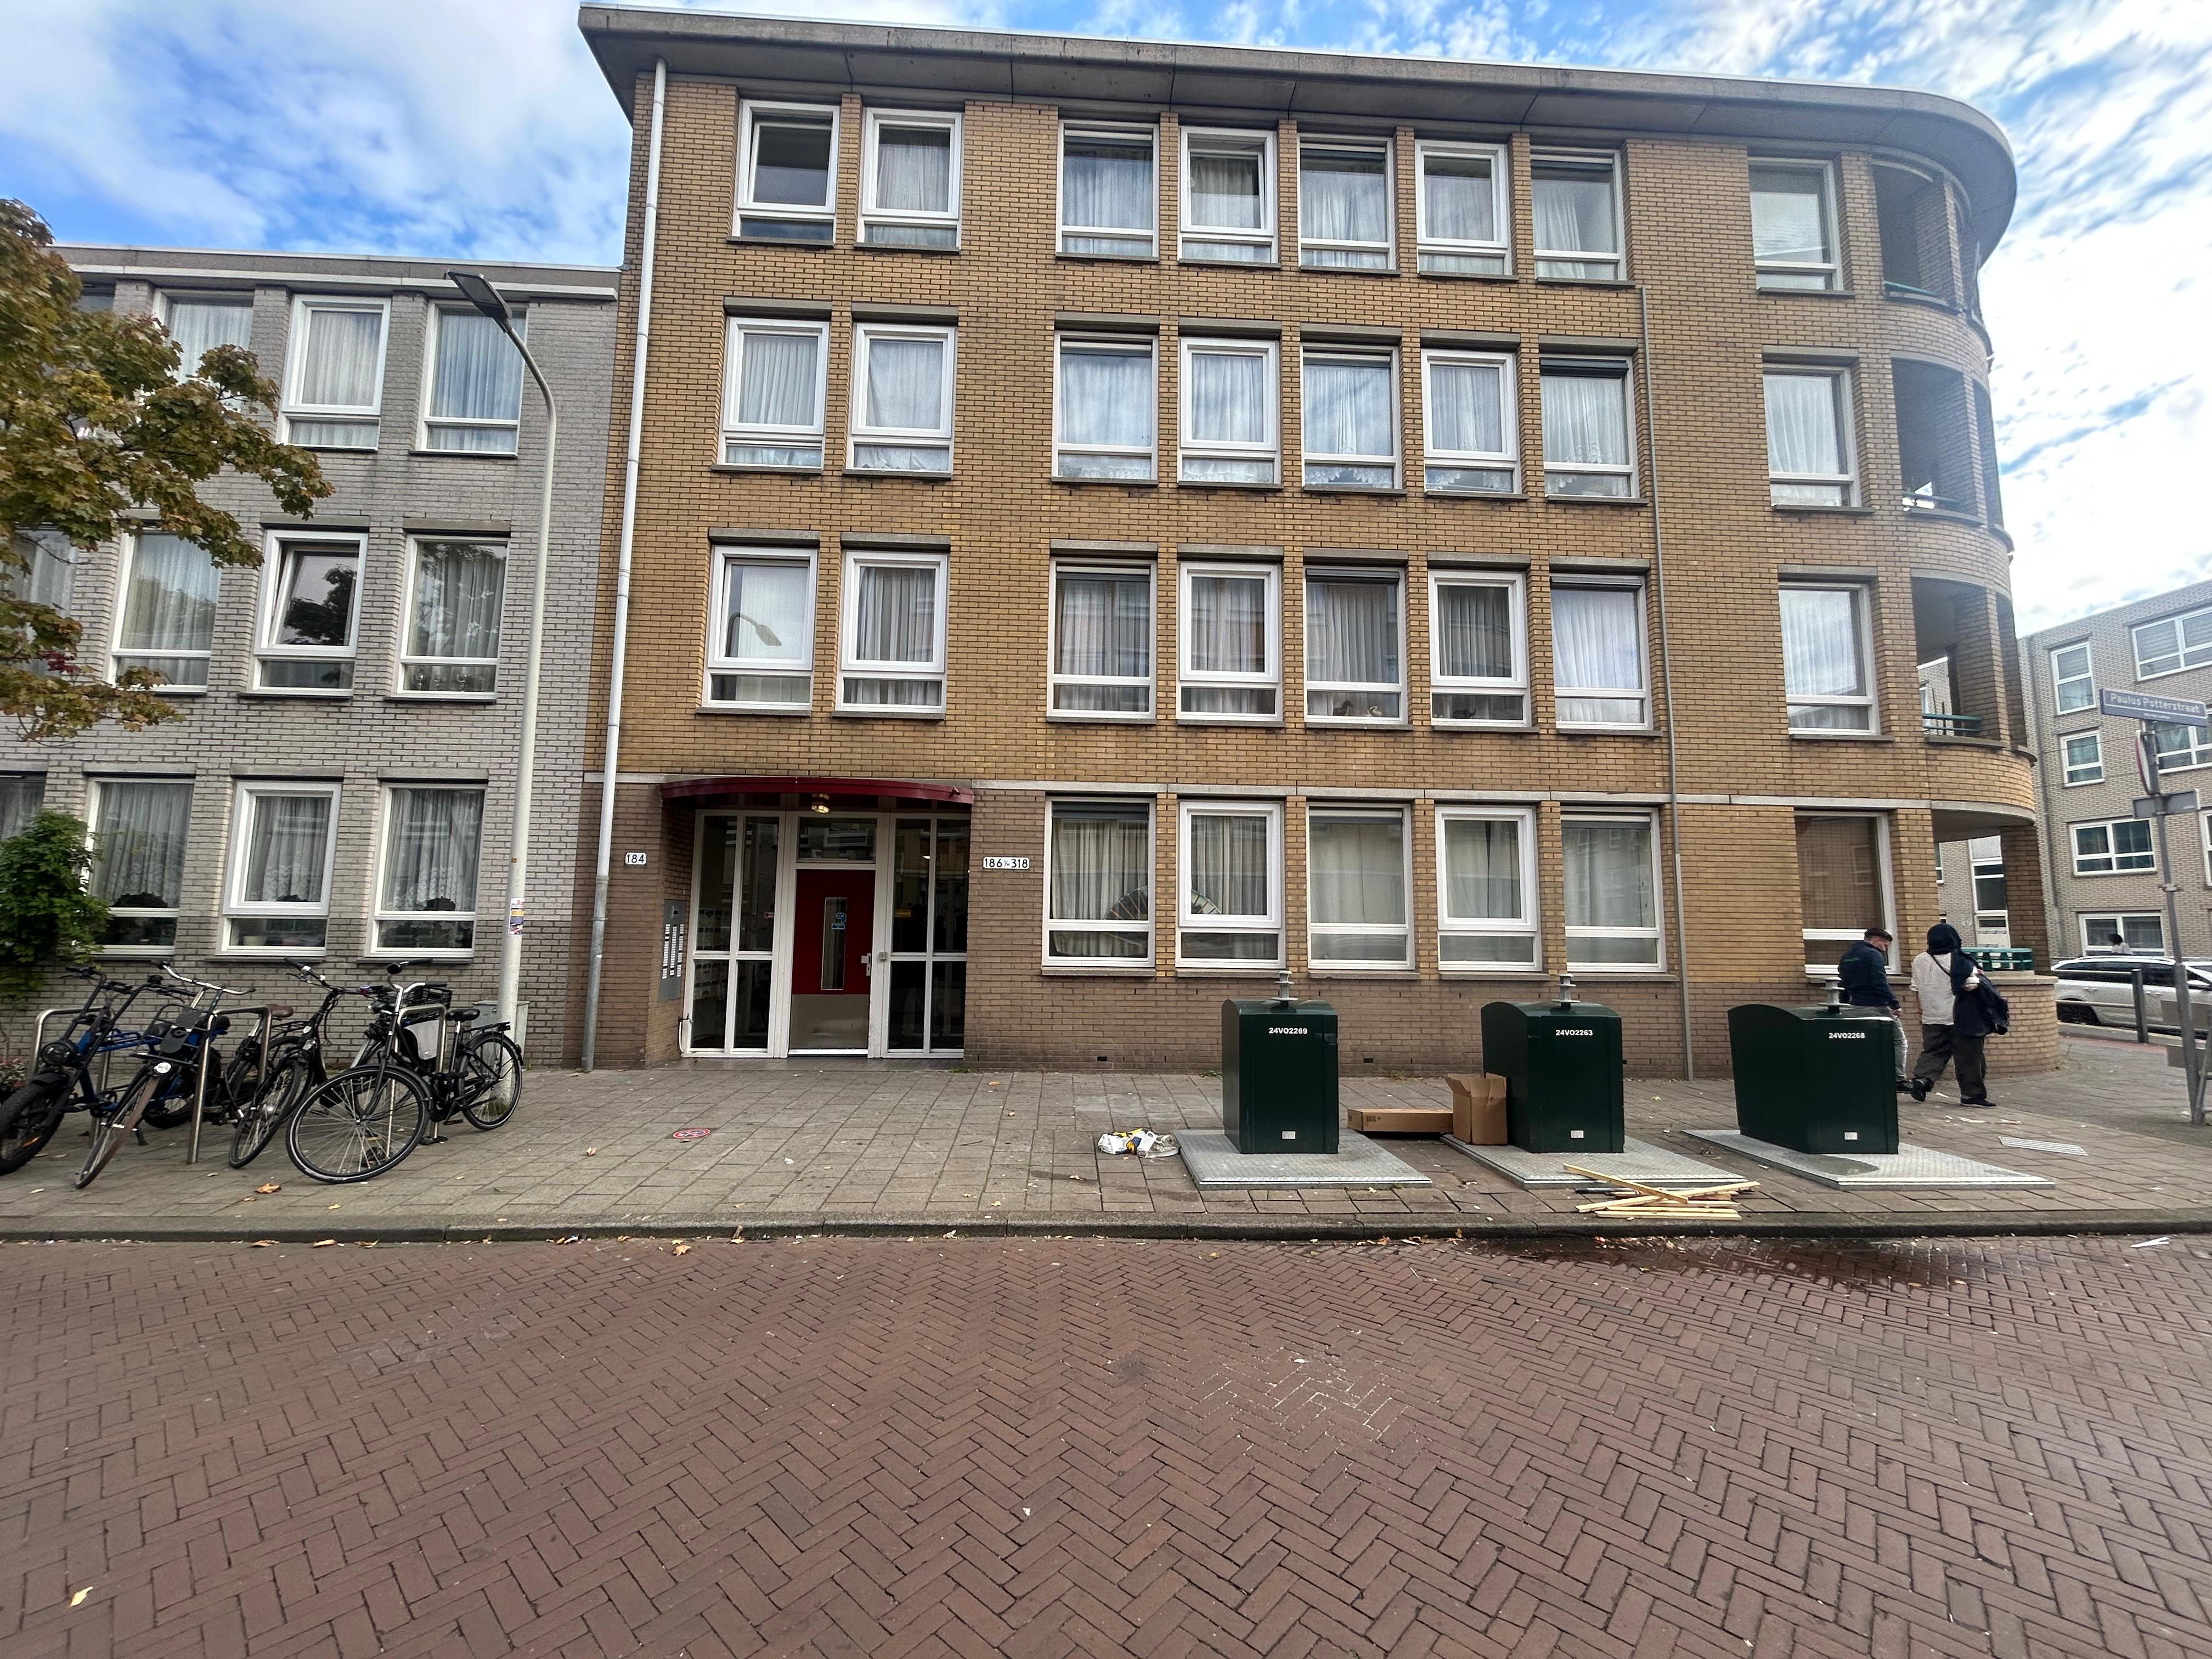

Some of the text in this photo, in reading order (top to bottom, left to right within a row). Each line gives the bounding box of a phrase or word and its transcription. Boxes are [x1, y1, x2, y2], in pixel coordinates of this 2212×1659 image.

[2110, 693, 2200, 713] Paulus Potterstraat
[627, 854, 644, 864] 184
[985, 858, 1002, 867] 186
[1011, 859, 1028, 868] 318
